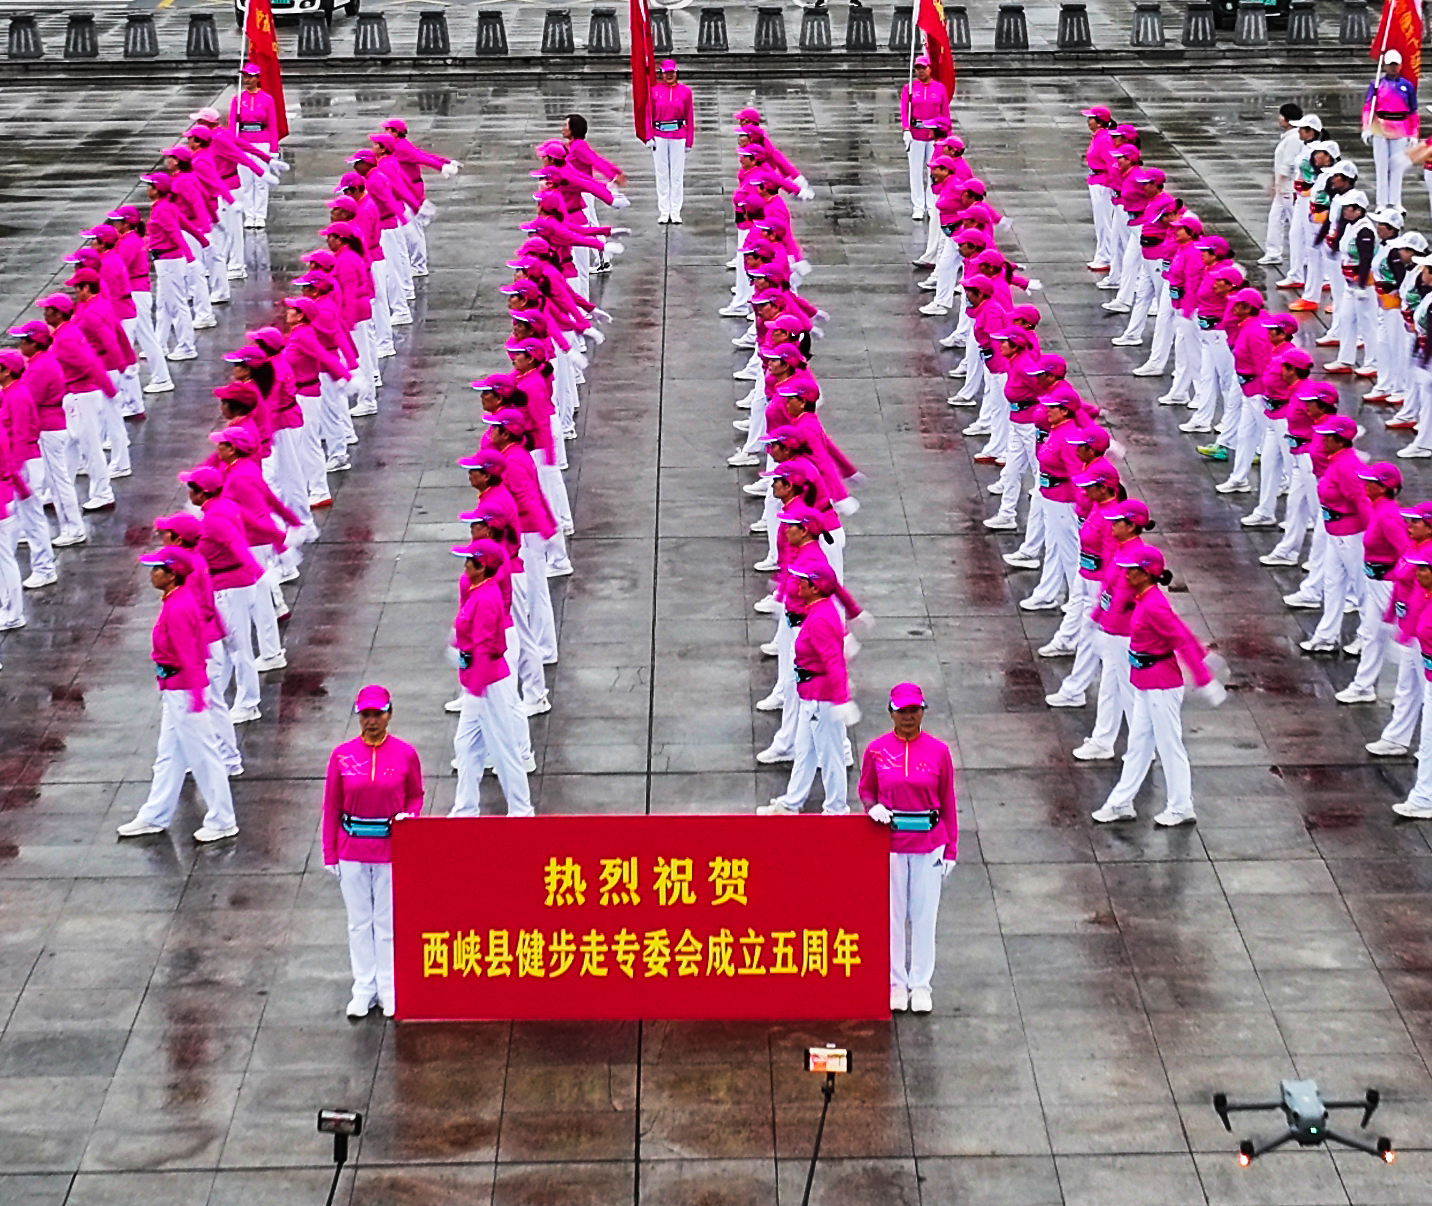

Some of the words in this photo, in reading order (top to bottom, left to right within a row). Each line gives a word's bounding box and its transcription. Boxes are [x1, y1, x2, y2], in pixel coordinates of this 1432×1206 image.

[544, 856, 749, 906] 热烈祝贺
[421, 928, 861, 978] 西峡县健步走专委会成立五周年
